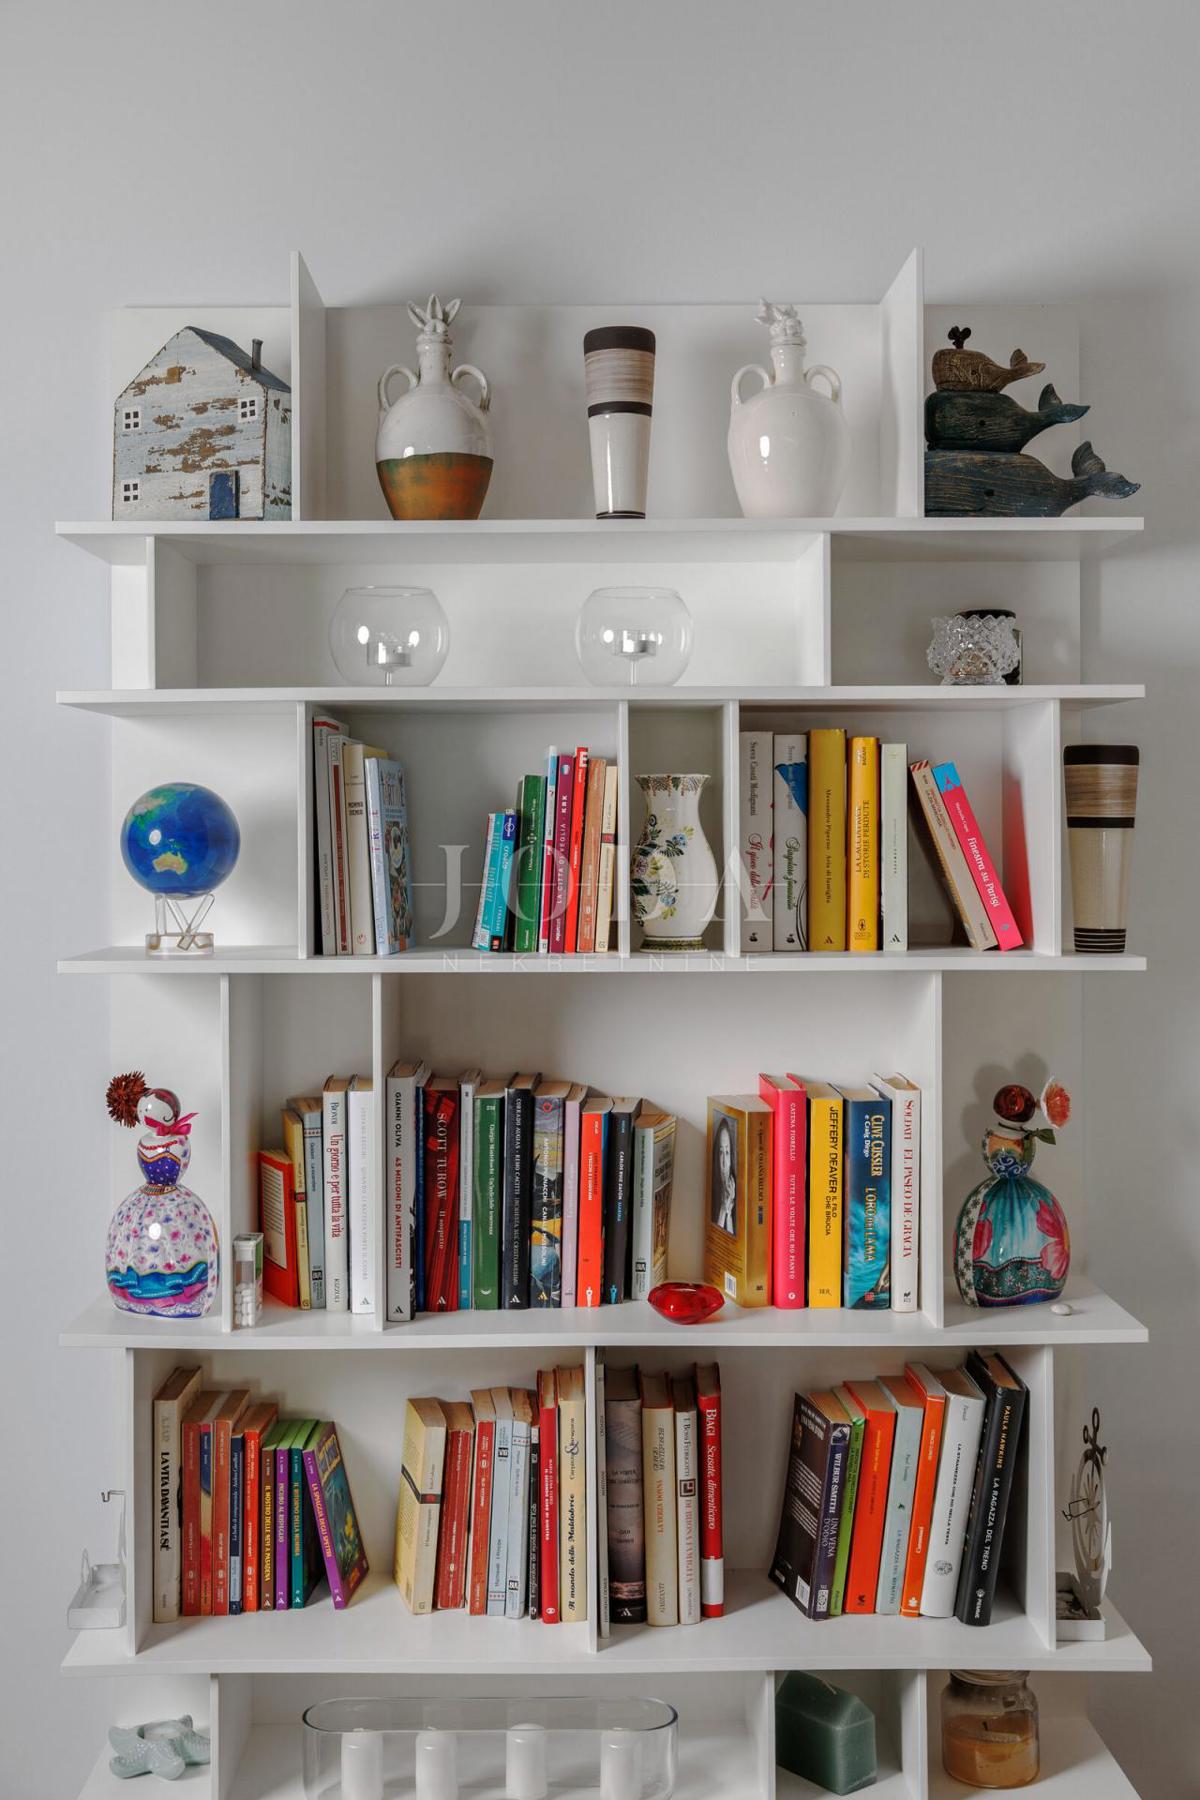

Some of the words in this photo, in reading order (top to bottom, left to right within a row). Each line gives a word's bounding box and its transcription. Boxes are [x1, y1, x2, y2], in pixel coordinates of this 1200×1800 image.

[967, 836, 987, 870] Finestra
[984, 882, 999, 908] Parigi
[437, 1112, 448, 1152] SCOTT
[829, 1106, 838, 1151] JEFFERY
[871, 1115, 884, 1138] CLIVE
[903, 1099, 913, 1140] SOLDATI
[331, 1134, 343, 1146] Un
[327, 1147, 343, 1172] giorno
[871, 1140, 884, 1177] CUSSLER
[903, 1149, 913, 1164] EL
[394, 1169, 402, 1201] MILIONI
[437, 1156, 448, 1199] TUROW
[829, 1152, 838, 1193] DEAVER
[903, 1166, 913, 1199] PASEO
[327, 1181, 340, 1195] per
[789, 1196, 796, 1205] LE
[332, 1195, 343, 1214] tutta
[394, 1204, 402, 1213] DI
[903, 1201, 913, 1217] DE
[332, 1215, 344, 1223] la
[332, 1223, 343, 1238] vita
[394, 1215, 402, 1269] ANTIFASCISTI
[789, 1244, 796, 1253] HO
[903, 1219, 913, 1259] GRACIA
[706, 1408, 717, 1436] BIAGI
[1001, 1405, 1011, 1430] PAULA
[161, 1452, 170, 1464] LA
[996, 1432, 1007, 1469] HAWKINS
[161, 1464, 170, 1487] VITA
[831, 1453, 842, 1483] WILBUR
[992, 1477, 1000, 1488] LA
[161, 1488, 170, 1529] DAVANTI
[707, 1479, 717, 1530] dimenticavo
[829, 1484, 839, 1513] SMITH
[987, 1490, 999, 1527] RAGAZZA
[567, 1494, 575, 1543] Maldobrie
[829, 1518, 838, 1536] UNA
[827, 1537, 837, 1558] VENA
[984, 1529, 993, 1544] DEL
[980, 1546, 990, 1571] TRENO
[568, 1601, 576, 1611] Il
